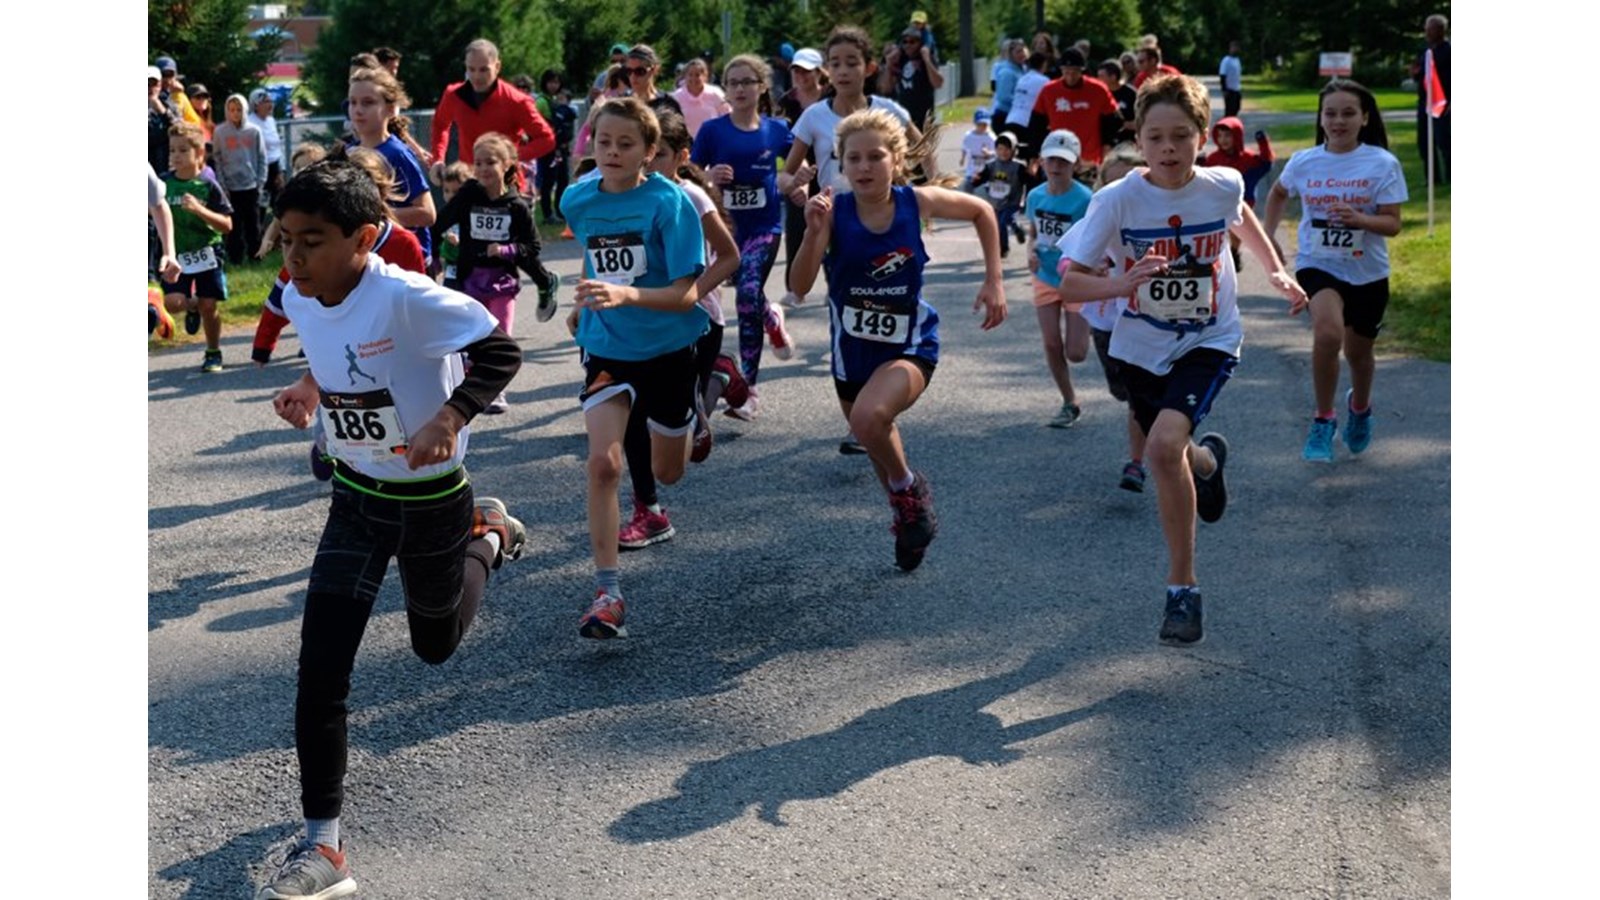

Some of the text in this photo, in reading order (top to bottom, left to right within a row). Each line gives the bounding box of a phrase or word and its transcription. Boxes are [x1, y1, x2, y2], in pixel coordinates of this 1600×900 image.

[1307, 179, 1322, 188] La
[731, 191, 758, 205] 182
[476, 216, 503, 230] 587
[1040, 220, 1063, 236] 166
[1322, 230, 1353, 247] 172
[183, 250, 208, 265] 556
[595, 248, 634, 273] 180
[850, 285, 908, 296] SOULANGES
[1150, 280, 1199, 301] 603
[853, 310, 897, 337] 149
[328, 410, 386, 440] 186
